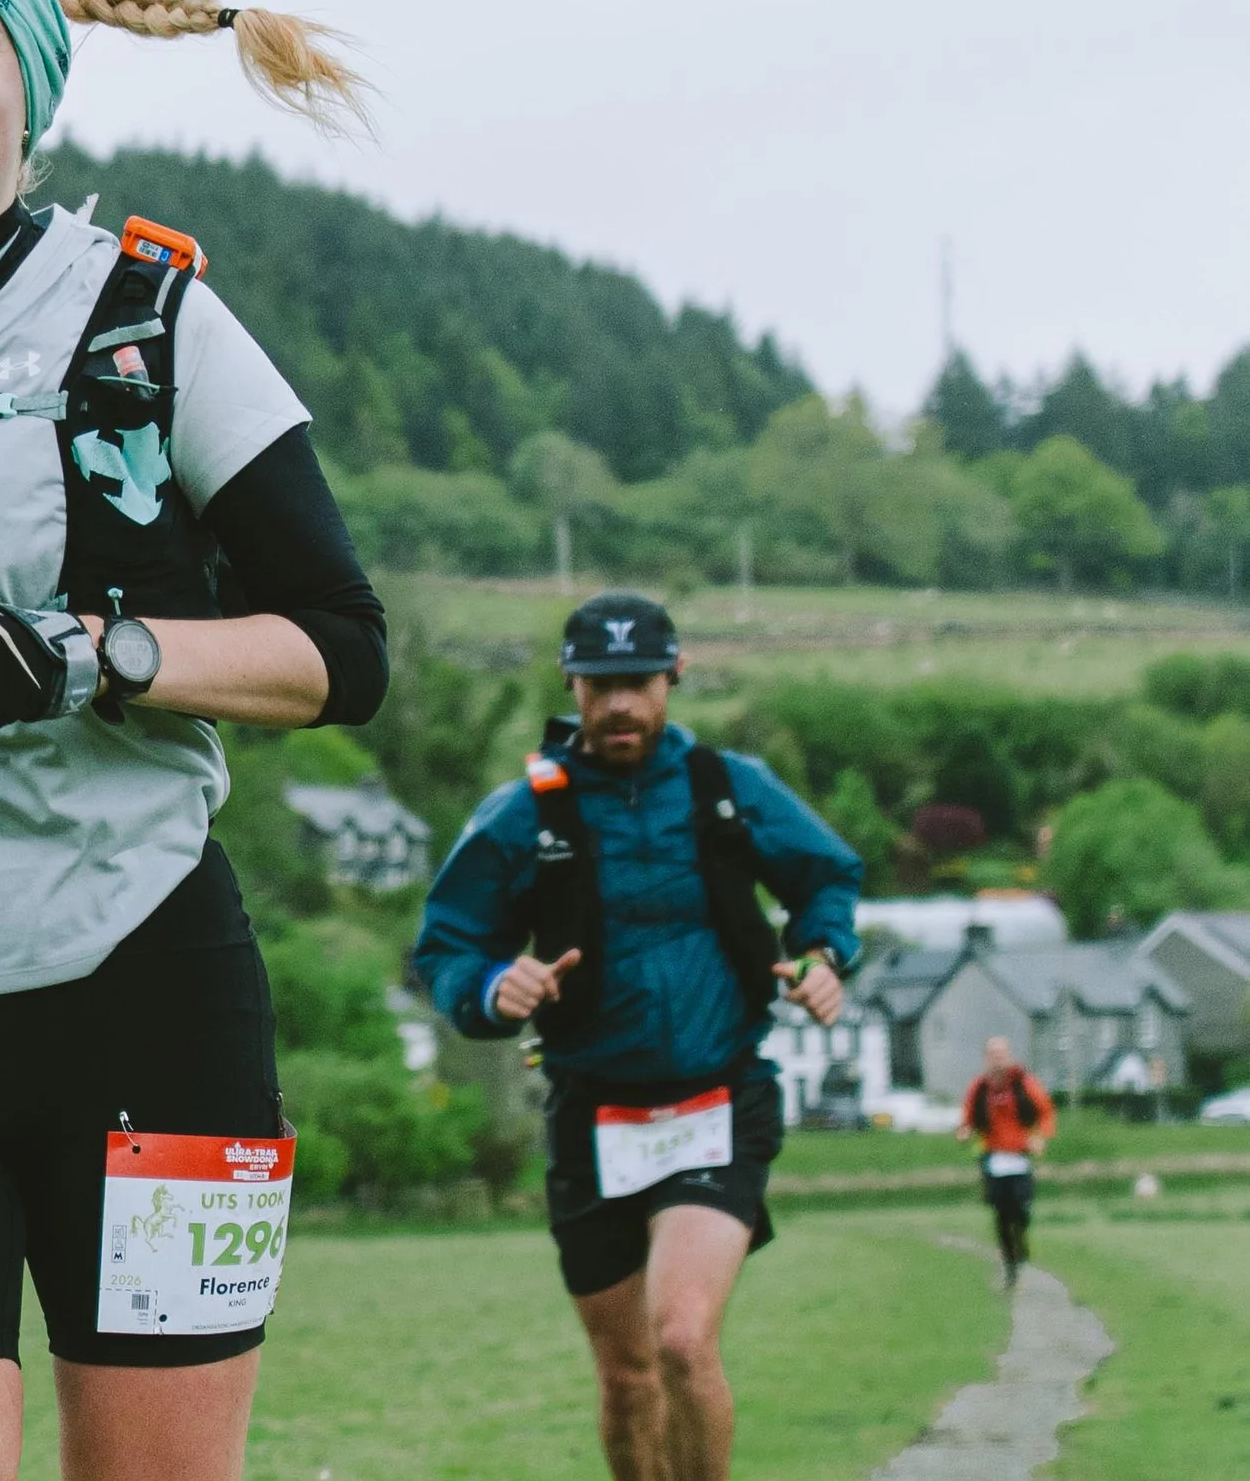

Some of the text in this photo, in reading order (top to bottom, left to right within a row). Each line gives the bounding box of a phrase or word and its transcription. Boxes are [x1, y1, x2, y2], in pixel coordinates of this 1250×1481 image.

[201, 1193, 238, 1210] UTS
[188, 1215, 286, 1267] 1296
[110, 1274, 142, 1286] 2026
[200, 1276, 270, 1296] Florence
[228, 1298, 247, 1308] KING
